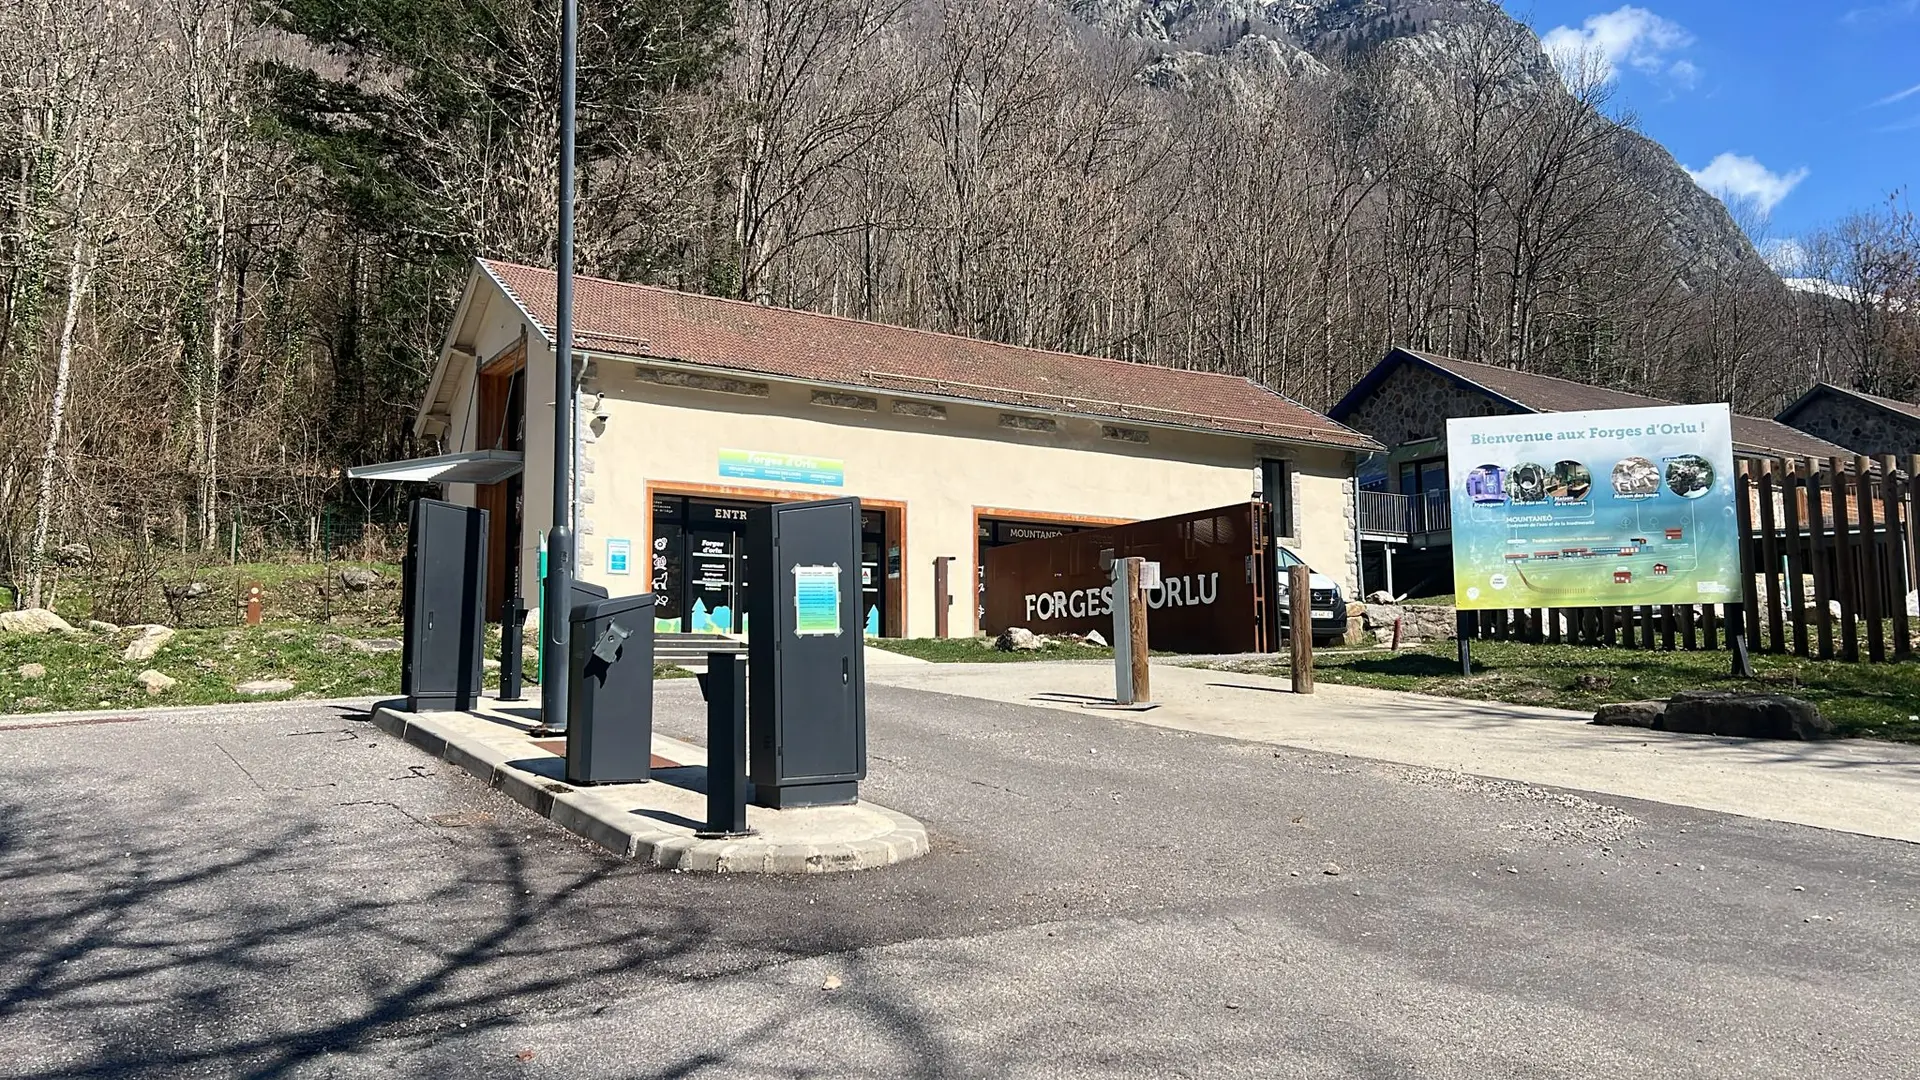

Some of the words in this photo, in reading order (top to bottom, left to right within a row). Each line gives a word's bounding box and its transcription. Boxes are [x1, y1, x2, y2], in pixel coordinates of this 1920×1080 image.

[1471, 432, 1553, 445] Bienvenue
[1557, 430, 1585, 441] aux
[1589, 427, 1642, 440] Forges
[1646, 423, 1697, 435] d'Orlu
[1701, 421, 1706, 433] !
[714, 508, 747, 520] ENTR
[1025, 586, 1114, 621] FORGES
[1147, 572, 1219, 609] ORLU
